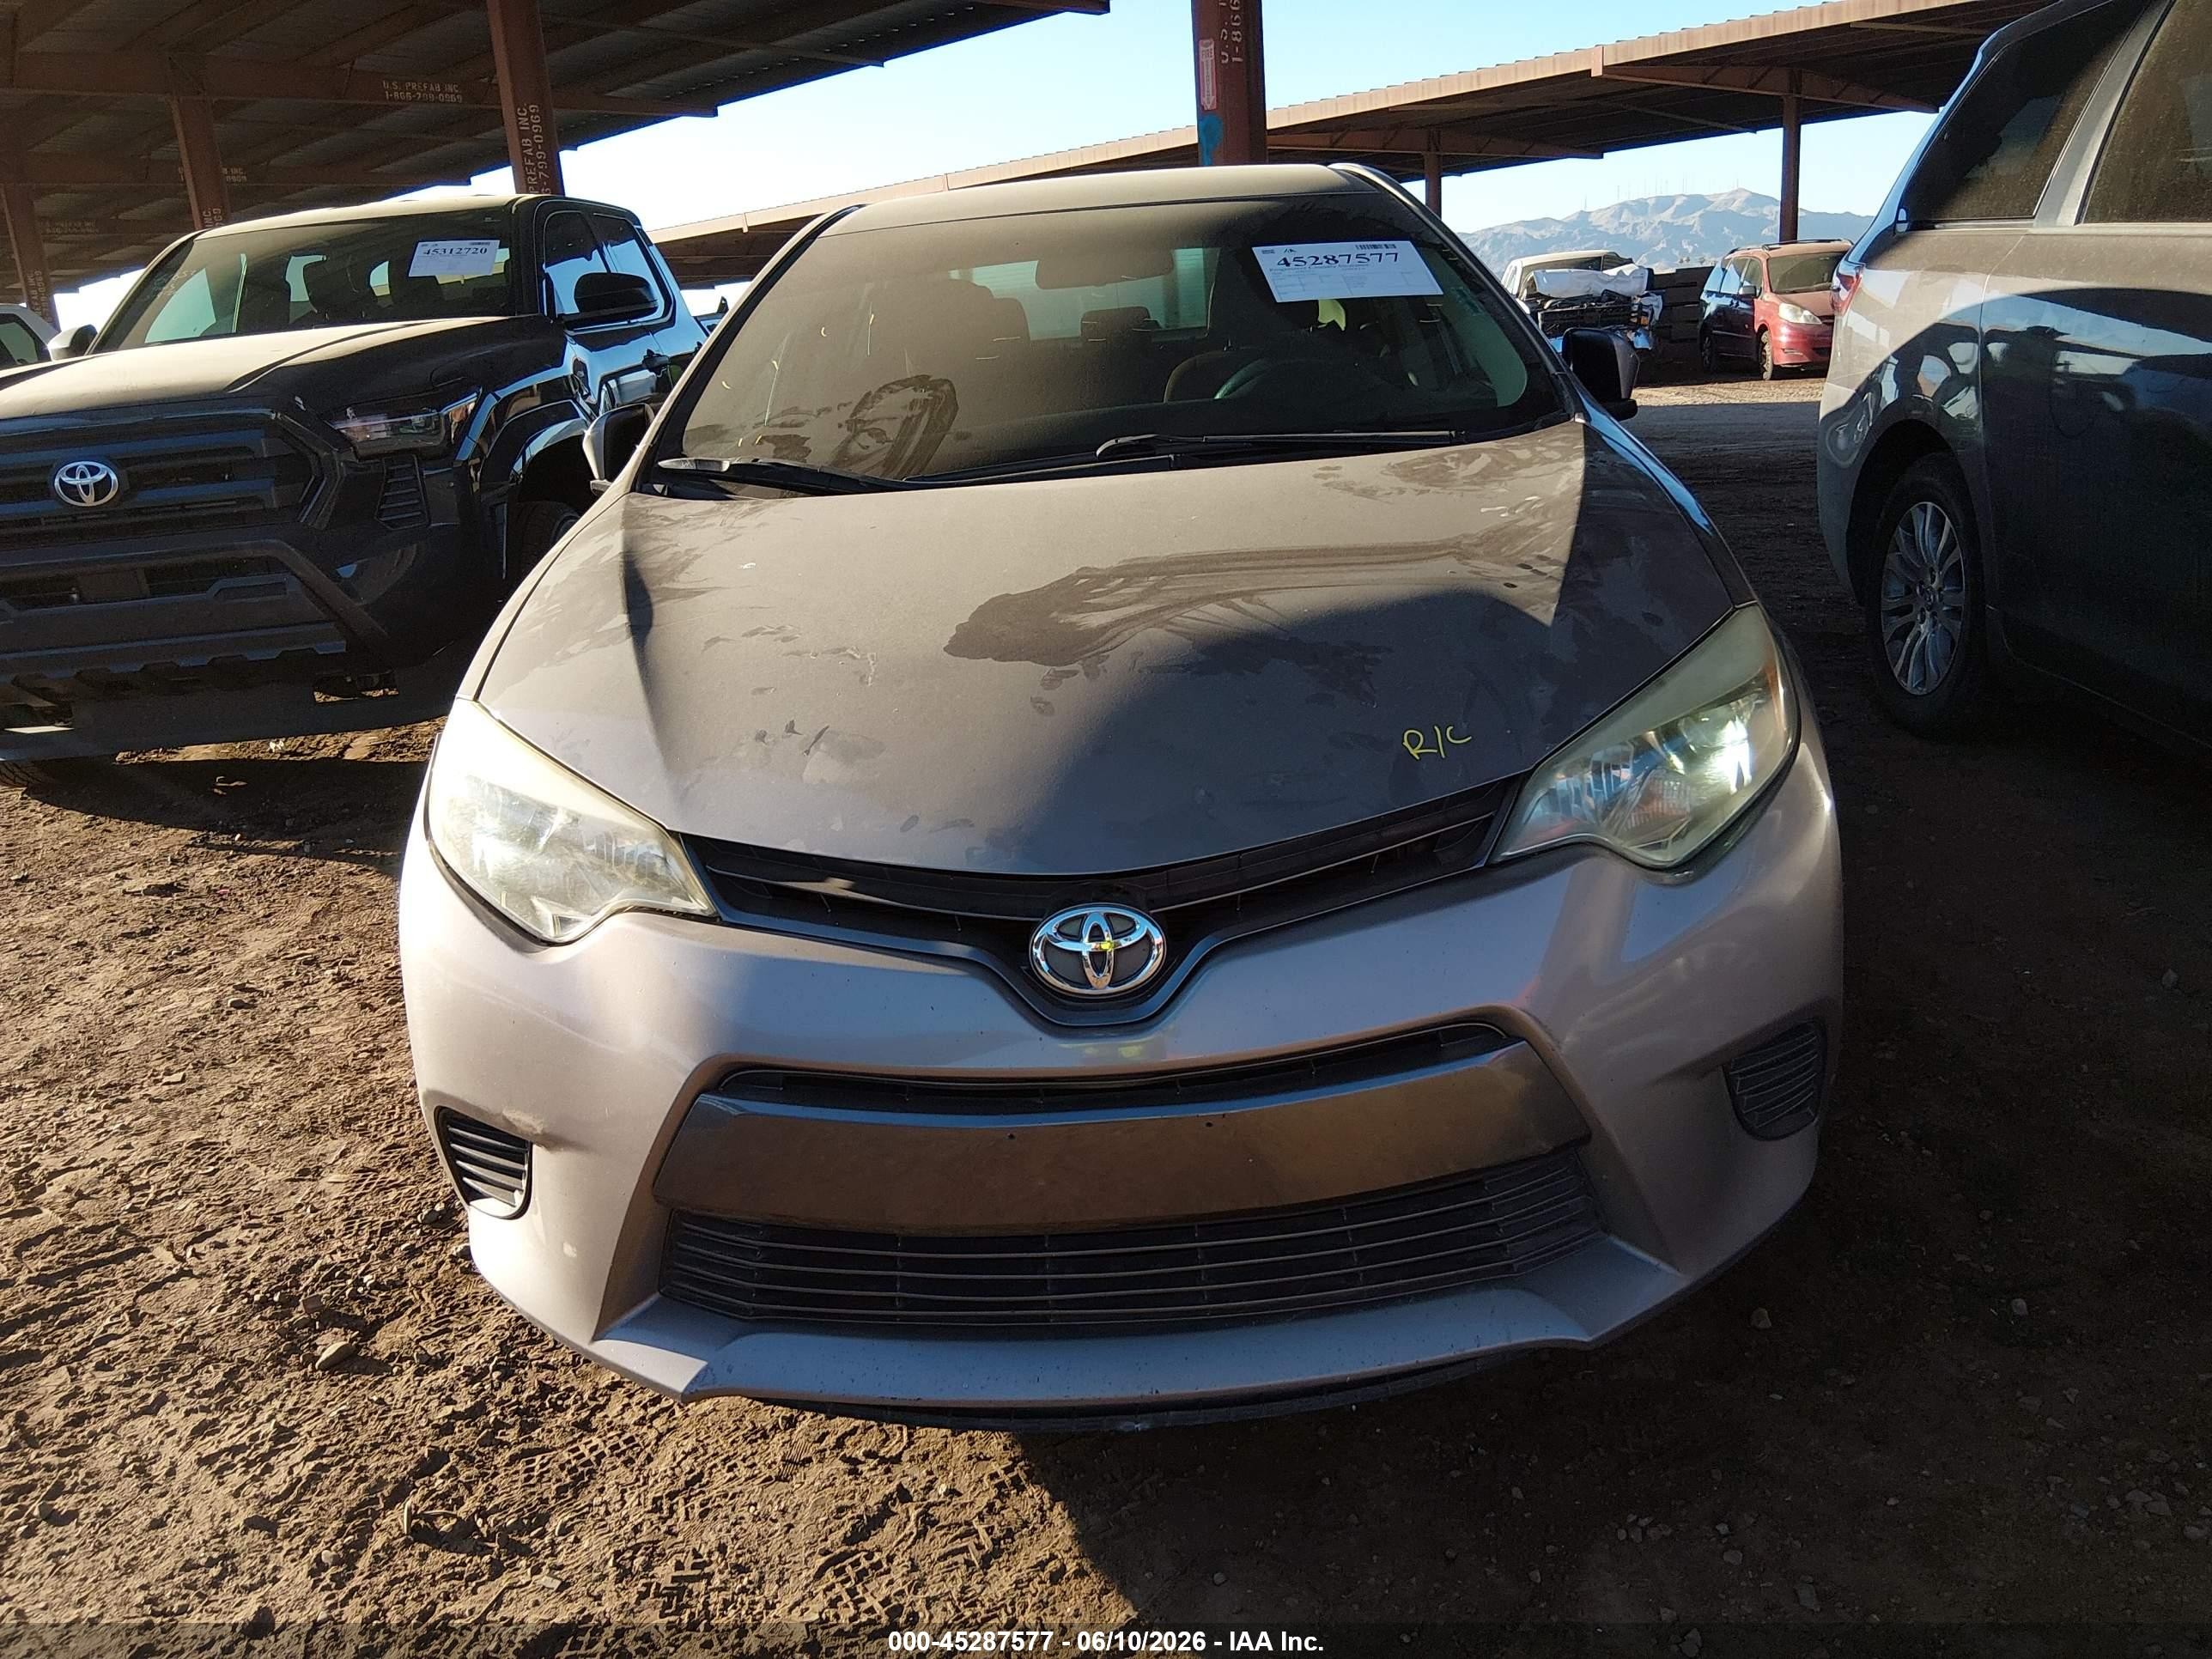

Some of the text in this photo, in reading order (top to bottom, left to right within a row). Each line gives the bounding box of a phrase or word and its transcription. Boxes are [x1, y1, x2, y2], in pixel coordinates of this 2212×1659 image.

[405, 82, 441, 92] PREFAB
[517, 103, 531, 131] INC.
[1278, 252, 1398, 267] 45287577
